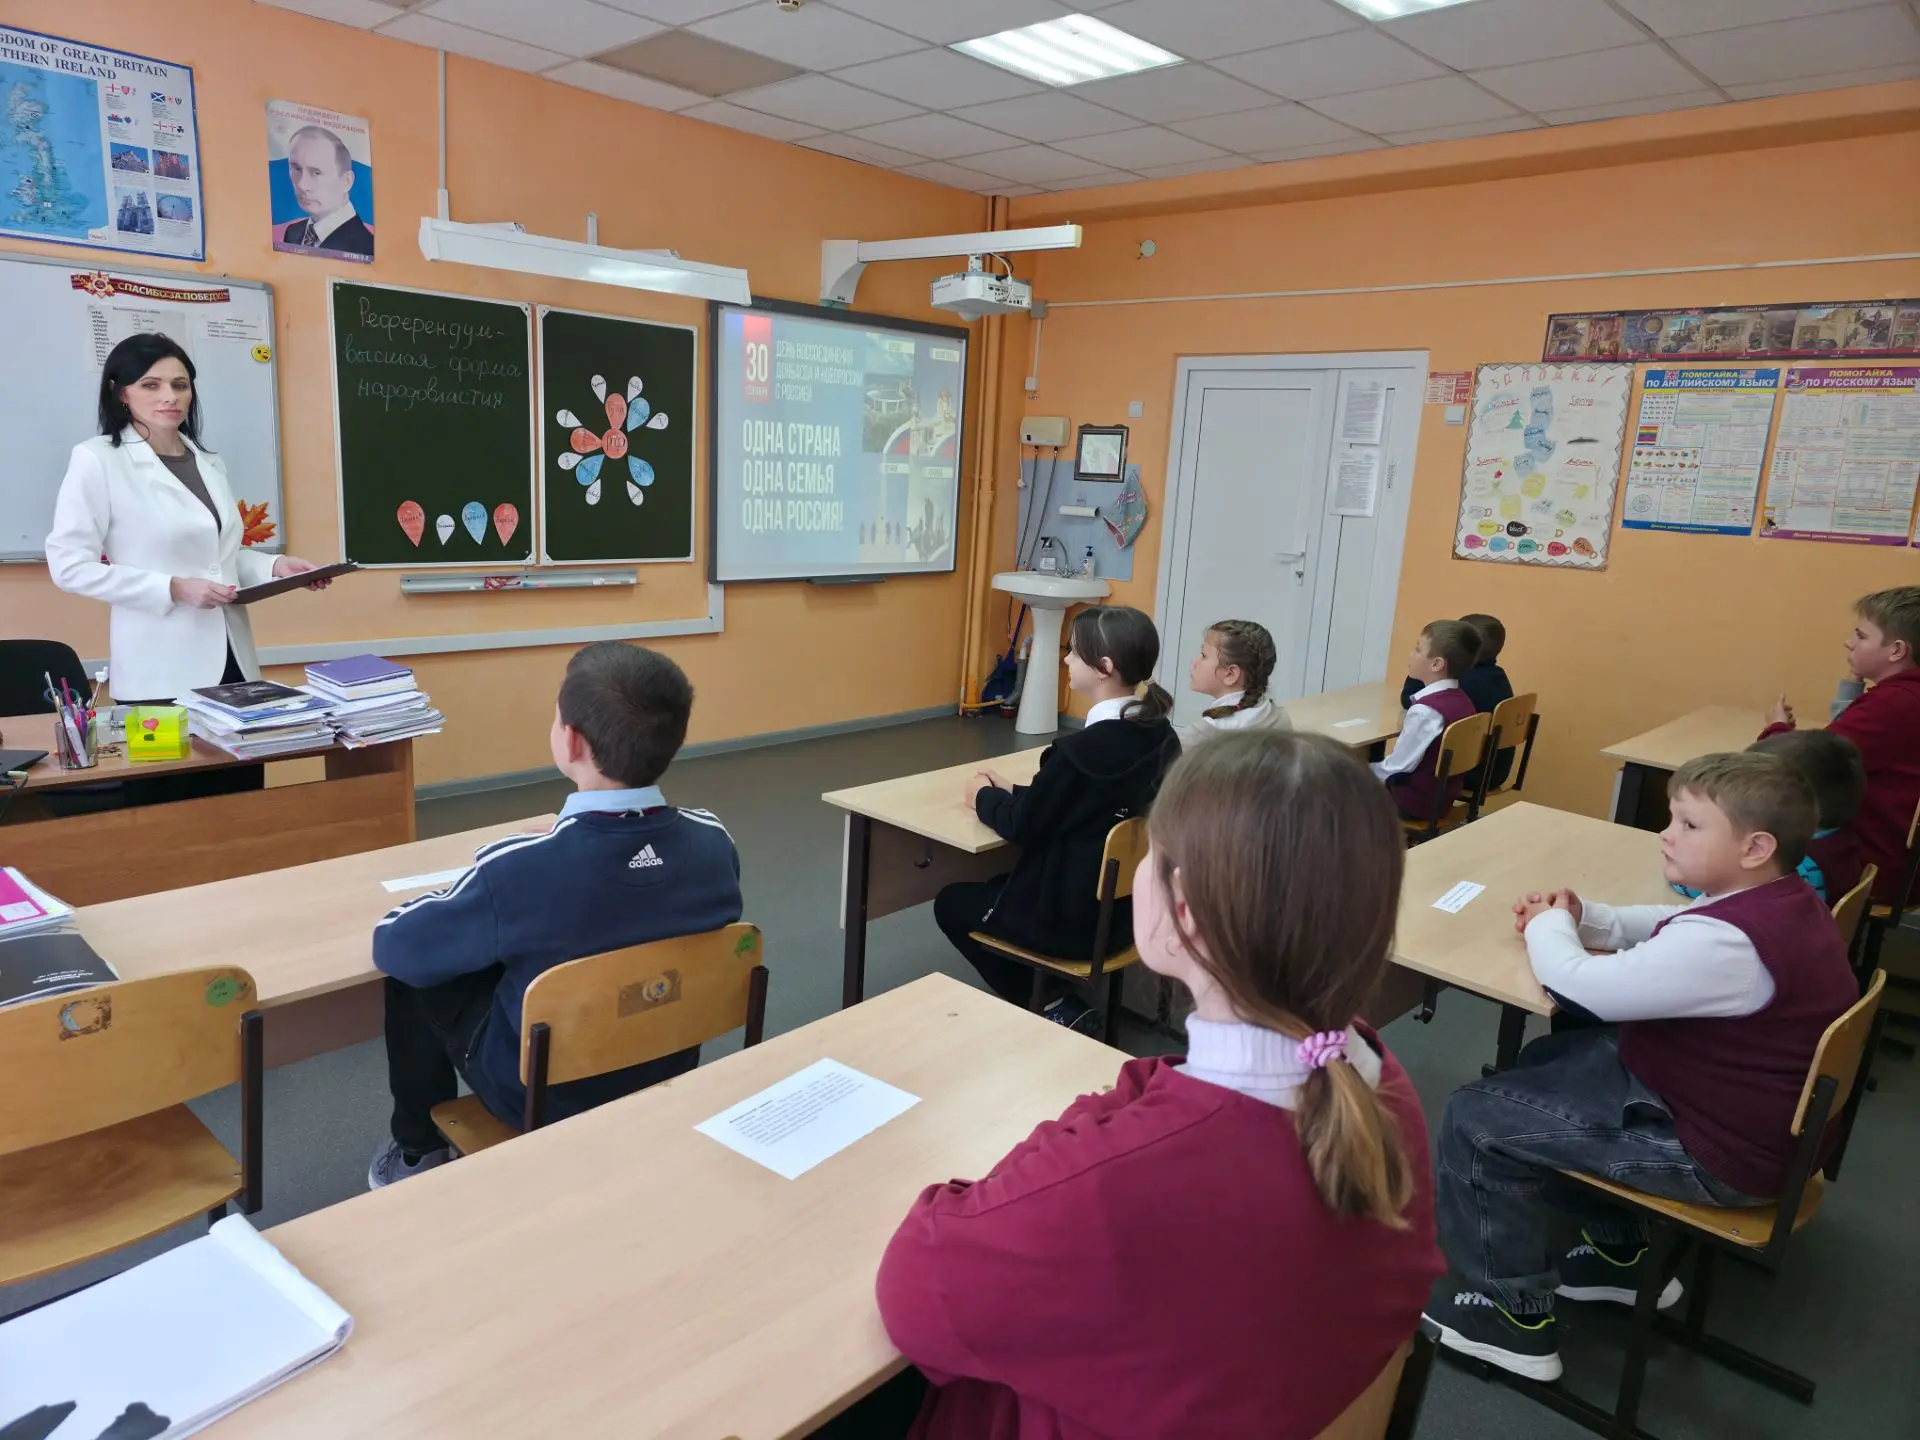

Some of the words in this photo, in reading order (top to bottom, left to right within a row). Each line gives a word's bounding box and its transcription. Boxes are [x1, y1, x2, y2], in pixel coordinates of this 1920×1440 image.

[41, 42, 58, 53] OF
[63, 46, 109, 65] GREAT
[113, 57, 168, 78] BRITAIN
[55, 58, 117, 80] IRELAND
[345, 334, 437, 370] высшая
[449, 356, 522, 382] форма
[746, 342, 769, 382] 30
[1829, 369, 1893, 377] ПОМОГАЙКА
[358, 376, 505, 412] народовластия
[1646, 379, 1660, 388] ПО
[1661, 377, 1737, 388] АНГЛИЙСКОМУ
[1738, 378, 1776, 387] ЯЗЫКУ
[1805, 379, 1820, 387] ПО
[1822, 378, 1880, 387] РУССКОМУ
[743, 419, 784, 456] ОДНА
[788, 423, 841, 457] СТРАНА
[743, 460, 784, 495] ОДНА
[788, 462, 834, 493] СЕМЬЯ
[743, 498, 783, 534] ОДНА
[787, 500, 844, 531] РОССИЯ!
[628, 857, 663, 868] adidas
